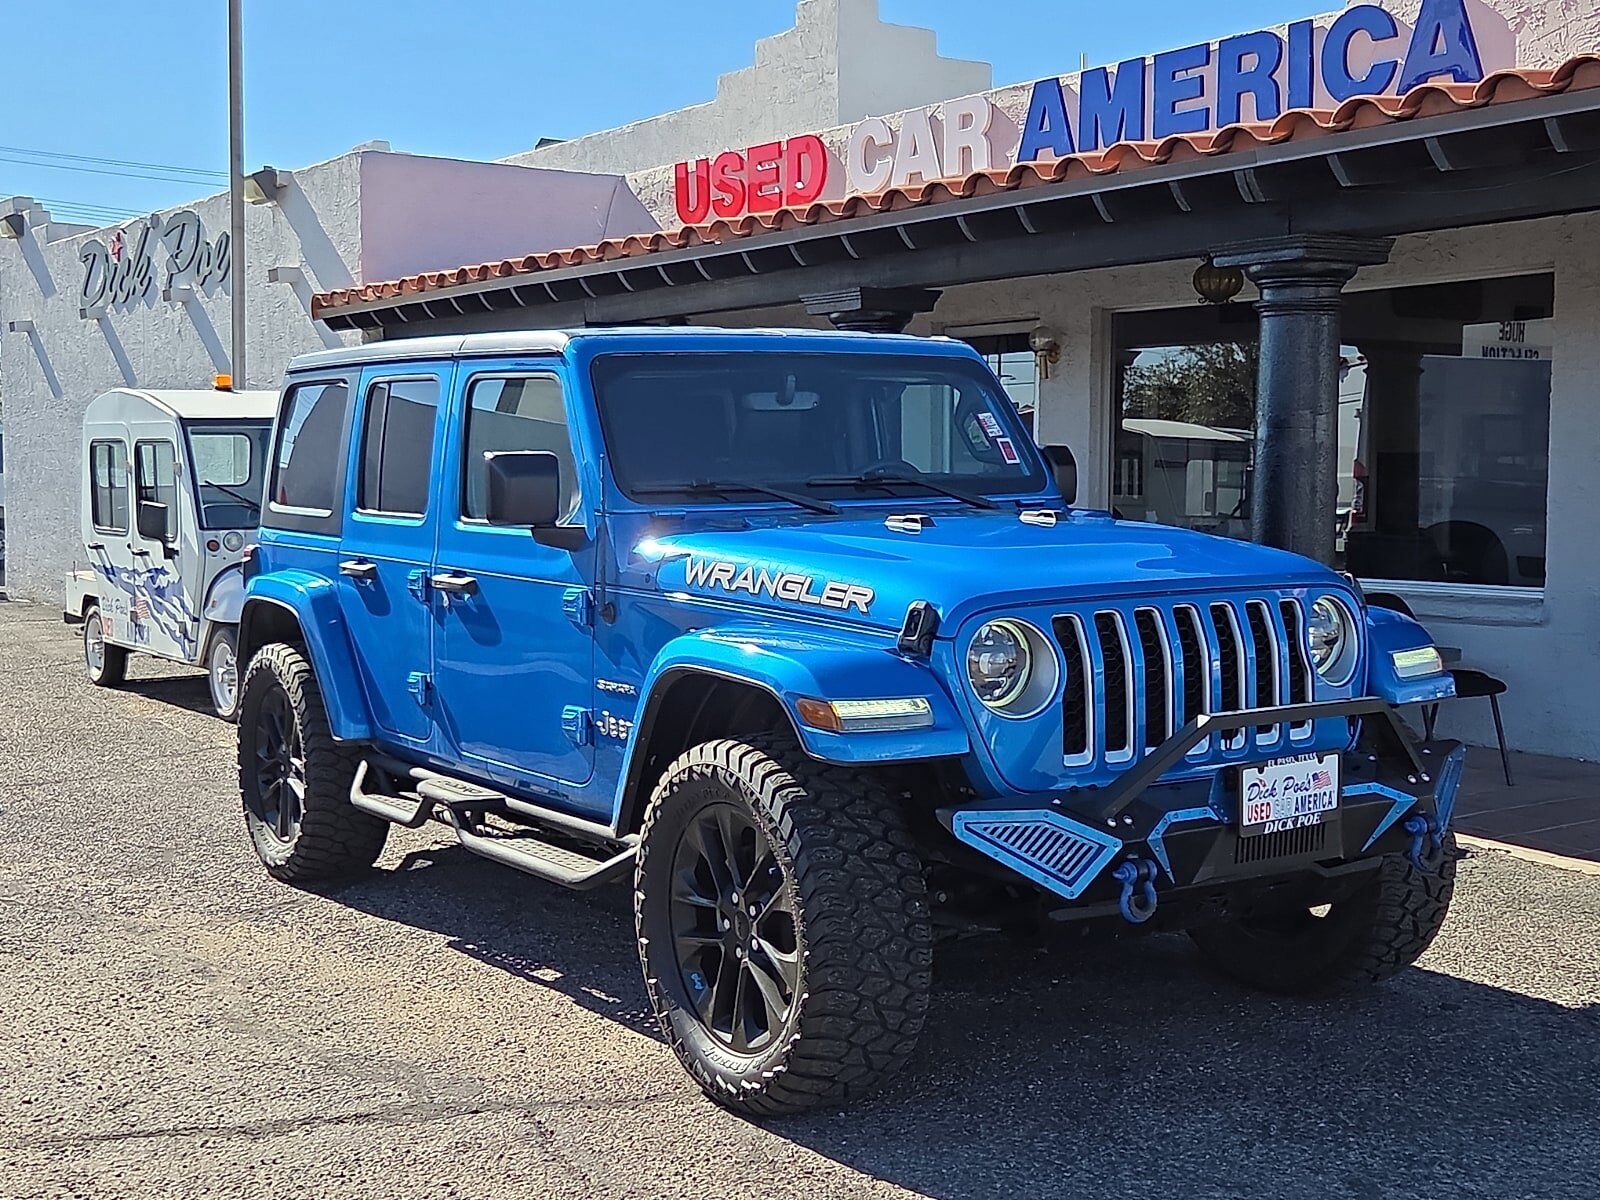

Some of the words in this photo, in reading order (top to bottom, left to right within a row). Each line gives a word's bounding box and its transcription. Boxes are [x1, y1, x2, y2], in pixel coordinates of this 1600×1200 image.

[674, 133, 829, 226] USED
[848, 98, 992, 194] CAR
[1017, 0, 1485, 163] AMERICA
[79, 220, 154, 308] Dick
[164, 210, 231, 292] Poe
[684, 555, 875, 614] WRANGLER
[1247, 778, 1278, 802] Dick
[1282, 773, 1312, 798] Poe's
[1247, 802, 1272, 823] USED
[1294, 789, 1334, 815] AMERICA
[1263, 816, 1296, 835] DICK
[1296, 812, 1322, 829] POE
